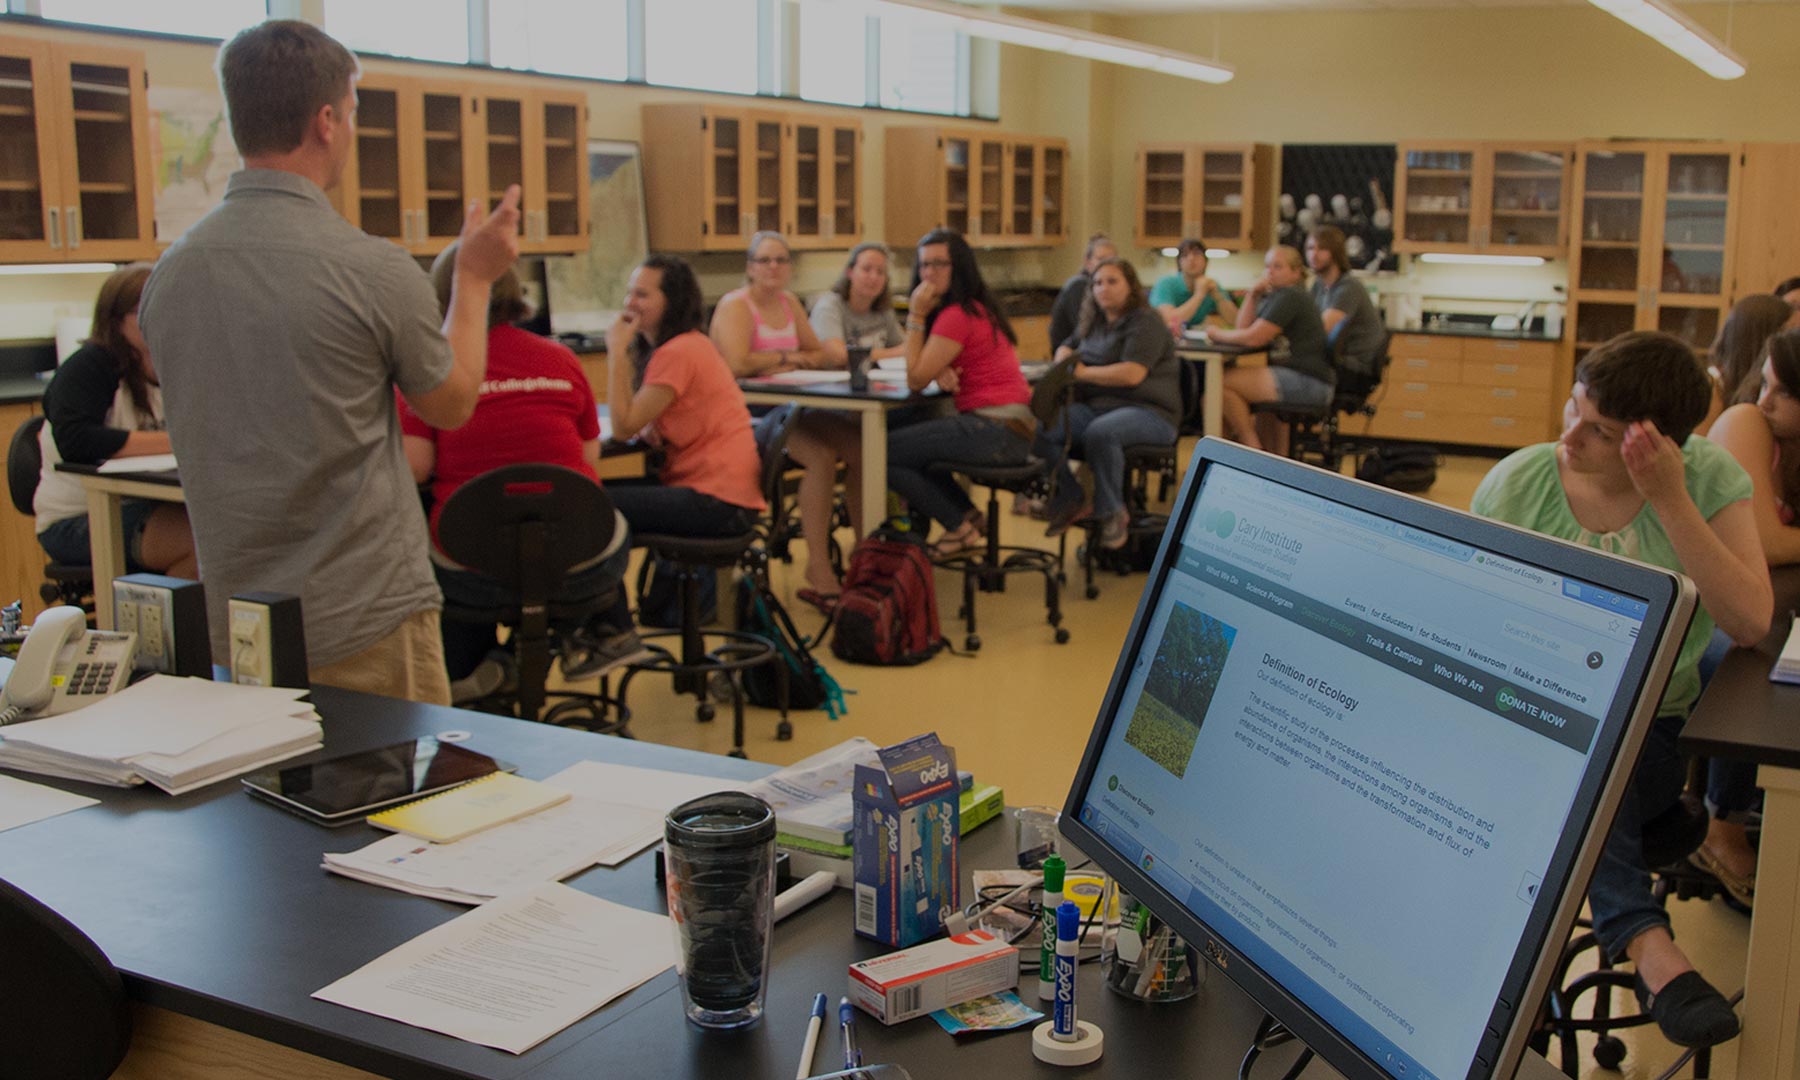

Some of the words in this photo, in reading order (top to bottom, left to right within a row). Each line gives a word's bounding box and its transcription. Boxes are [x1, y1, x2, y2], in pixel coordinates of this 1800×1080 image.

[1238, 517, 1261, 541] Cary
[1261, 525, 1303, 555] Institute
[1486, 557, 1513, 574] Definition
[1513, 565, 1521, 576] of
[1521, 568, 1545, 584] Ecology
[1344, 597, 1366, 613] Events
[1371, 608, 1380, 619] for
[1381, 611, 1414, 632] Educators
[1419, 627, 1429, 638] for
[1431, 632, 1462, 652] Students
[1467, 648, 1507, 671] Newsroom
[1513, 666, 1534, 682] Make
[1543, 678, 1588, 704] Difference
[1504, 622, 1530, 639] Search
[1531, 631, 1545, 646] this
[1546, 638, 1561, 652] site
[1257, 669, 1269, 682] Our
[1269, 677, 1299, 698] definition
[1299, 690, 1308, 701] of
[1308, 698, 1336, 718] ecology
[1262, 653, 1305, 683] Definition
[1306, 676, 1317, 689] of
[1318, 681, 1359, 711] Ecology
[1365, 633, 1385, 650] Trails
[1385, 641, 1393, 652] &
[1393, 646, 1424, 667] Campus
[1434, 663, 1453, 679] Who
[1453, 672, 1468, 686] We
[1468, 679, 1485, 693] Are
[1500, 691, 1539, 718] DONATE
[1539, 709, 1567, 729] NOW
[1234, 730, 1256, 750] energy
[1256, 743, 1269, 756] and
[1249, 690, 1261, 704] The
[1262, 699, 1290, 721] scientific
[1291, 714, 1310, 732] study
[1309, 725, 1319, 736] of
[1319, 730, 1330, 742] the
[1330, 738, 1369, 765] processes
[1370, 759, 1413, 790] influencing
[1413, 781, 1427, 796] the
[1428, 790, 1475, 823] distribution
[1476, 815, 1495, 833] and
[920, 760, 949, 784] EXPO
[1239, 718, 1274, 743] interactions
[1274, 738, 1304, 761] between
[1304, 755, 1341, 782] organisms
[1341, 776, 1357, 791] and
[1356, 784, 1369, 798] the
[1369, 792, 1426, 832] transformation
[1427, 827, 1445, 842] and
[1445, 836, 1461, 853] flux
[1462, 846, 1475, 859] of
[1243, 705, 1279, 730] abundance
[1278, 723, 1288, 734] of
[1324, 749, 1337, 762] the
[1337, 757, 1379, 787] interactions
[1380, 782, 1409, 805] among
[1409, 798, 1454, 831] organisms,
[1456, 825, 1475, 840] and
[1475, 834, 1491, 850] the
[885, 814, 899, 852] EXPO
[939, 802, 953, 846] EXPO
[1042, 911, 1056, 950] EXPO
[1056, 958, 1072, 1002] EXPO
